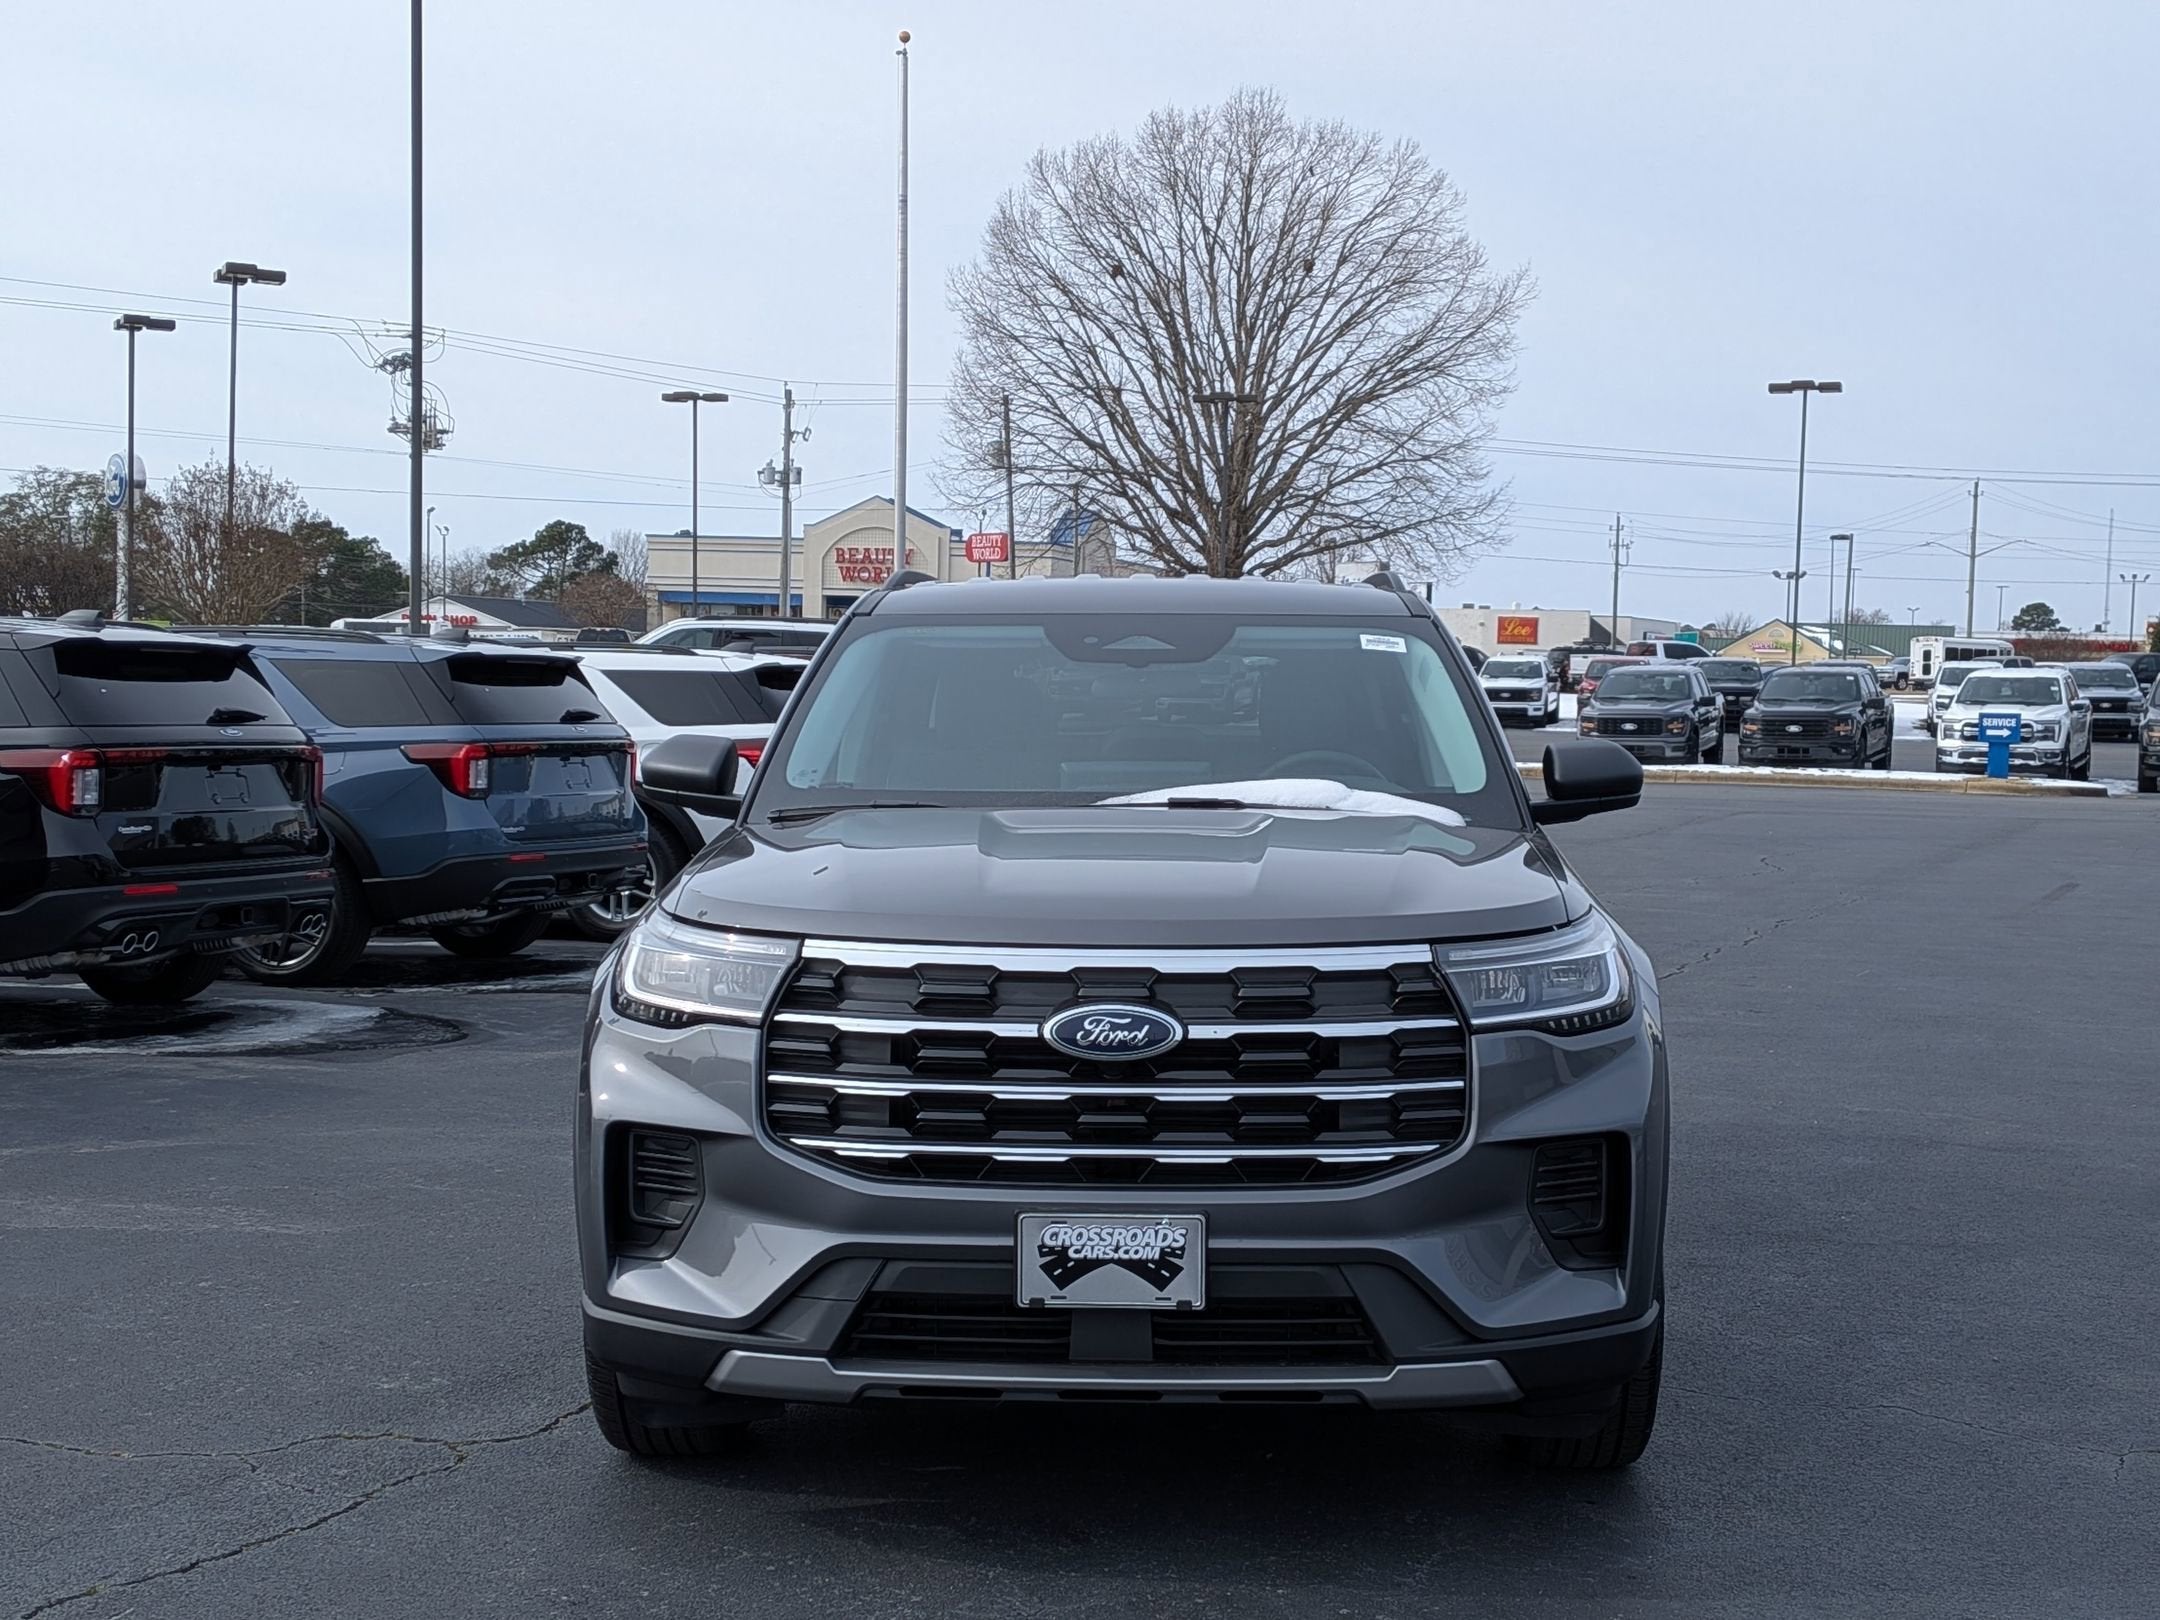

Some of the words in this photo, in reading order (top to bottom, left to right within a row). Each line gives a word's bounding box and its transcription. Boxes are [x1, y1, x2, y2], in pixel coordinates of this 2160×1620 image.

[971, 535, 1003, 547] BEAUTY
[972, 547, 1002, 560] WORLD
[1501, 617, 1534, 636] Lee
[1982, 717, 2017, 727] SERVICE
[1076, 1016, 1150, 1046] Ford
[1043, 1226, 1187, 1248] CROSSROADS
[1067, 1245, 1161, 1260] CARS.COM
